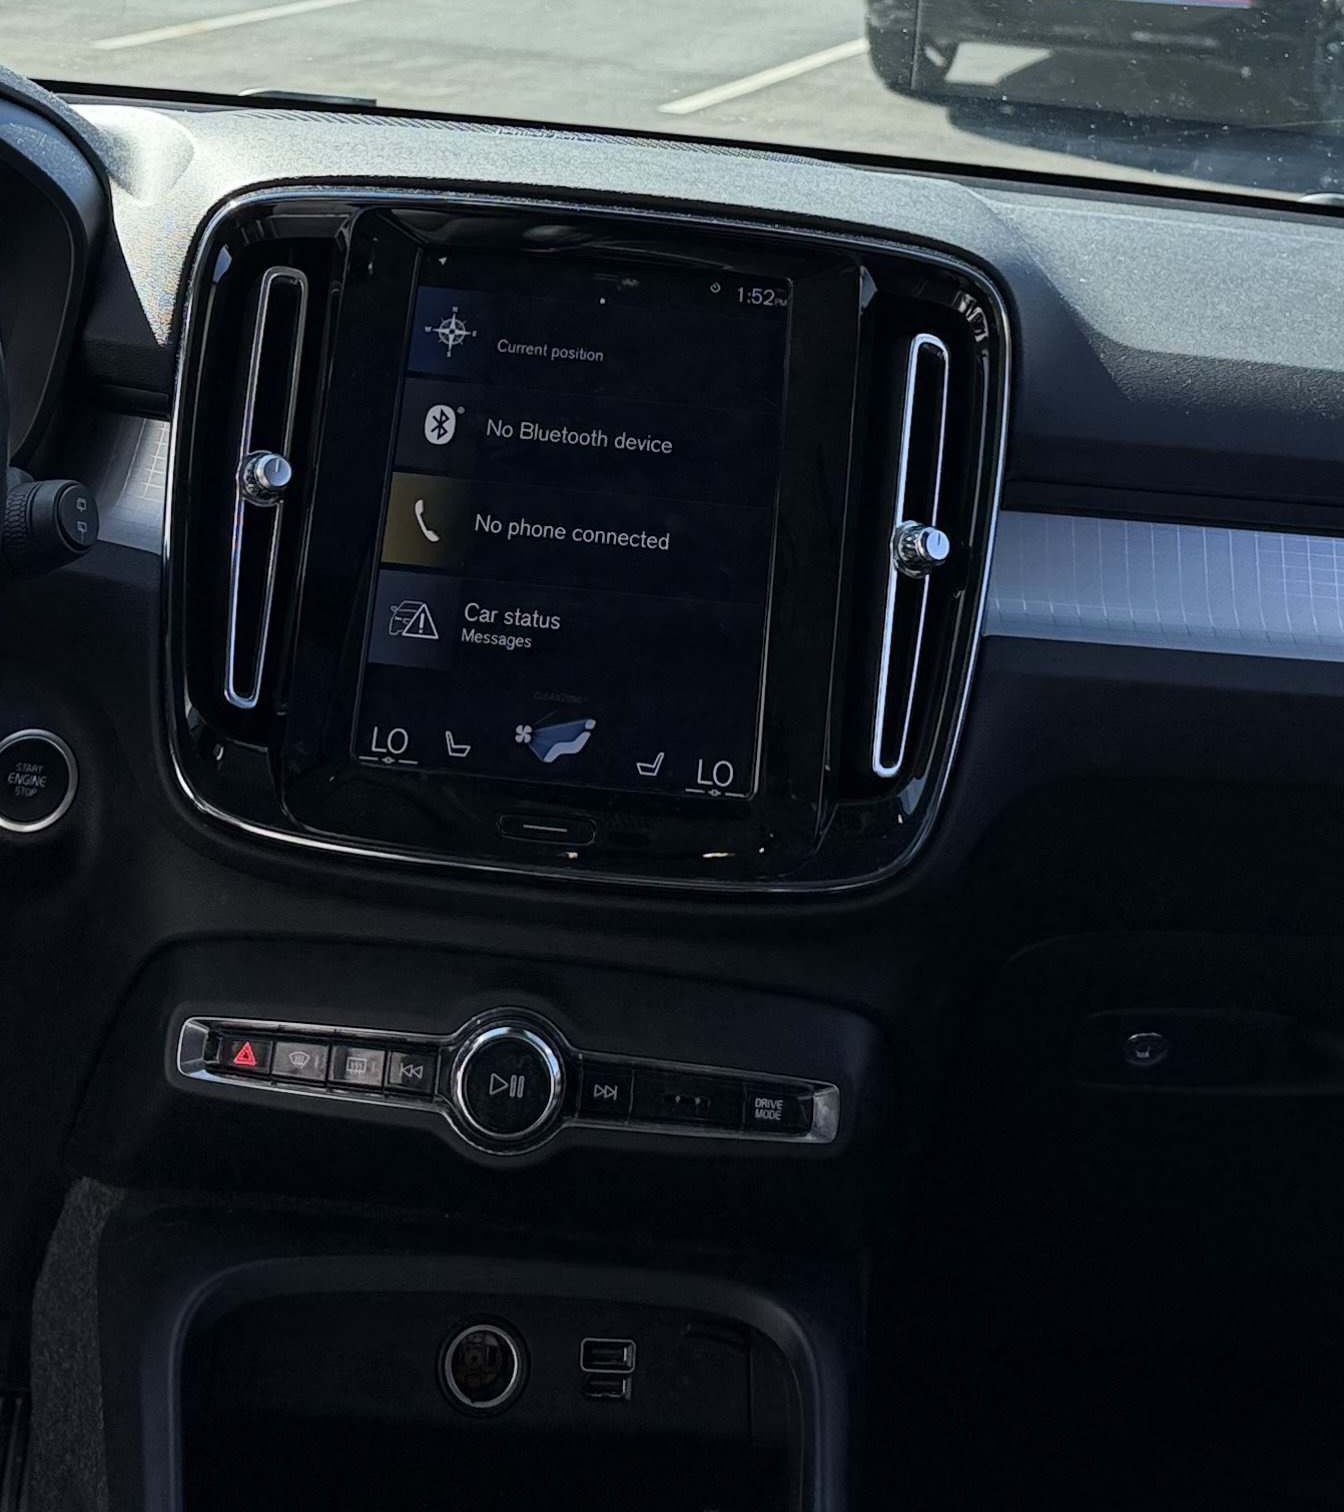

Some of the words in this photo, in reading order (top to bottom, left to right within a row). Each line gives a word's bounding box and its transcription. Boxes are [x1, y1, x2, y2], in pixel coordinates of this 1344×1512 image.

[497, 339, 548, 357] Current
[550, 346, 605, 363] position
[486, 418, 514, 438] No
[519, 421, 609, 448] Bluetooth
[613, 432, 674, 454] device
[474, 513, 503, 535] No
[507, 517, 567, 541] phone
[571, 528, 671, 551] connected
[464, 602, 500, 624] Car
[503, 607, 562, 631] status
[461, 627, 533, 651] Messages
[371, 726, 410, 755] LO
[8, 772, 48, 788] ENGINE
[16, 762, 44, 775] START
[697, 758, 734, 788] LO
[14, 786, 38, 797] STOP
[754, 1097, 784, 1110] DRIVE
[754, 1108, 782, 1120] MODE
